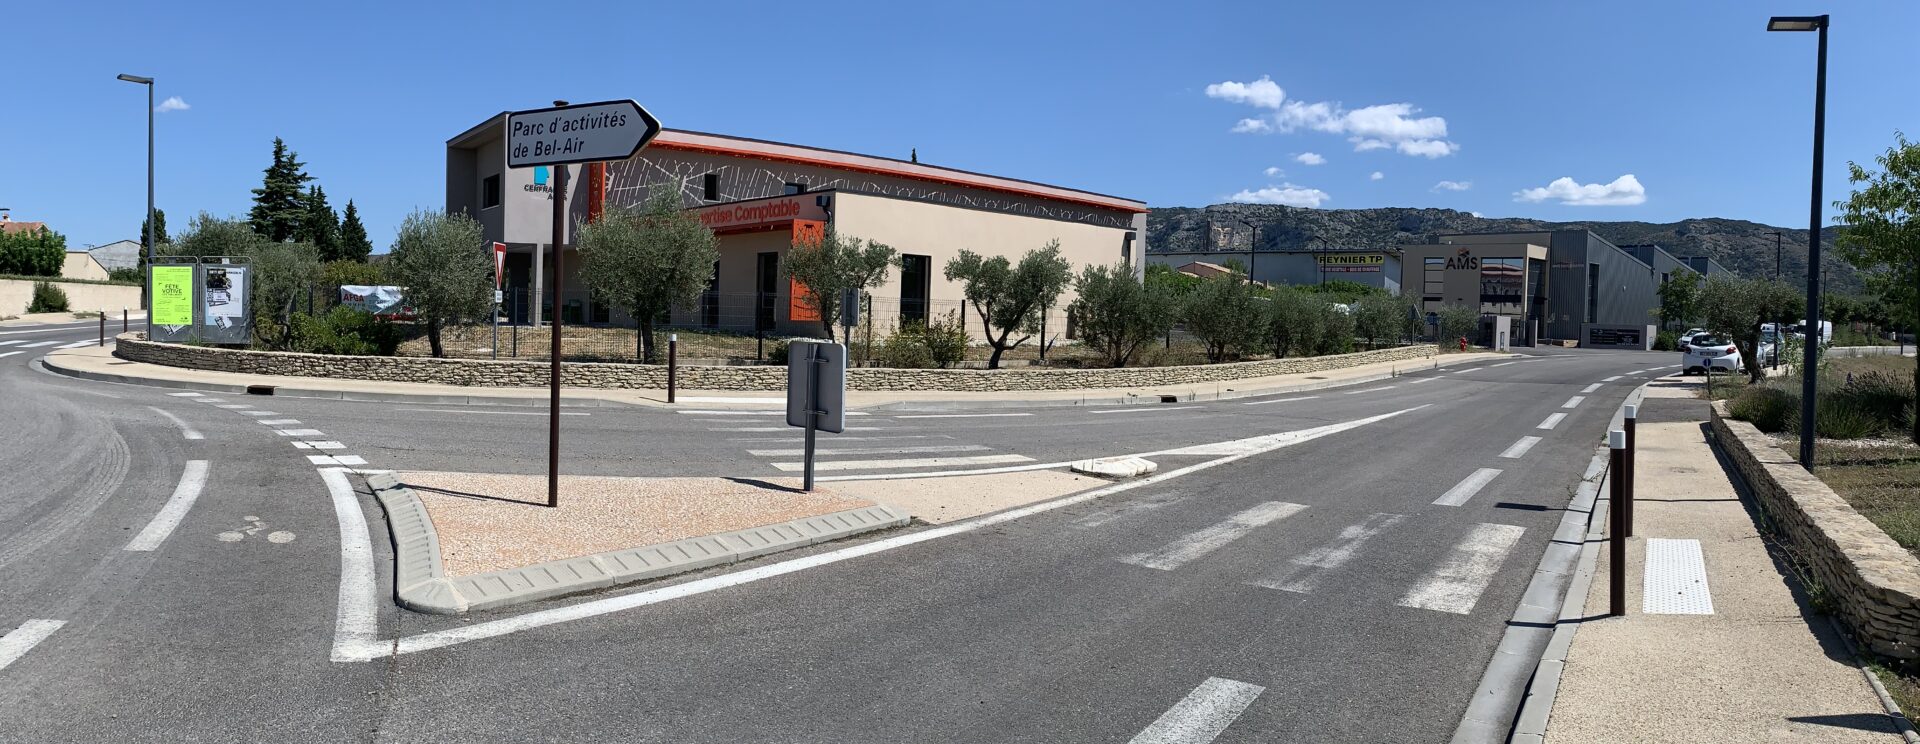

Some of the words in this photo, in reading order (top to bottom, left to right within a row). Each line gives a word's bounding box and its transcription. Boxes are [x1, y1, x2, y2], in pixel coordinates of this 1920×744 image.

[513, 121, 544, 137] Parc
[549, 111, 626, 134] d'activités
[513, 142, 528, 158] de
[534, 137, 585, 157] Bel-Air
[735, 199, 800, 223] Comptable
[1369, 255, 1383, 263] TP
[1445, 257, 1478, 270] AMS
